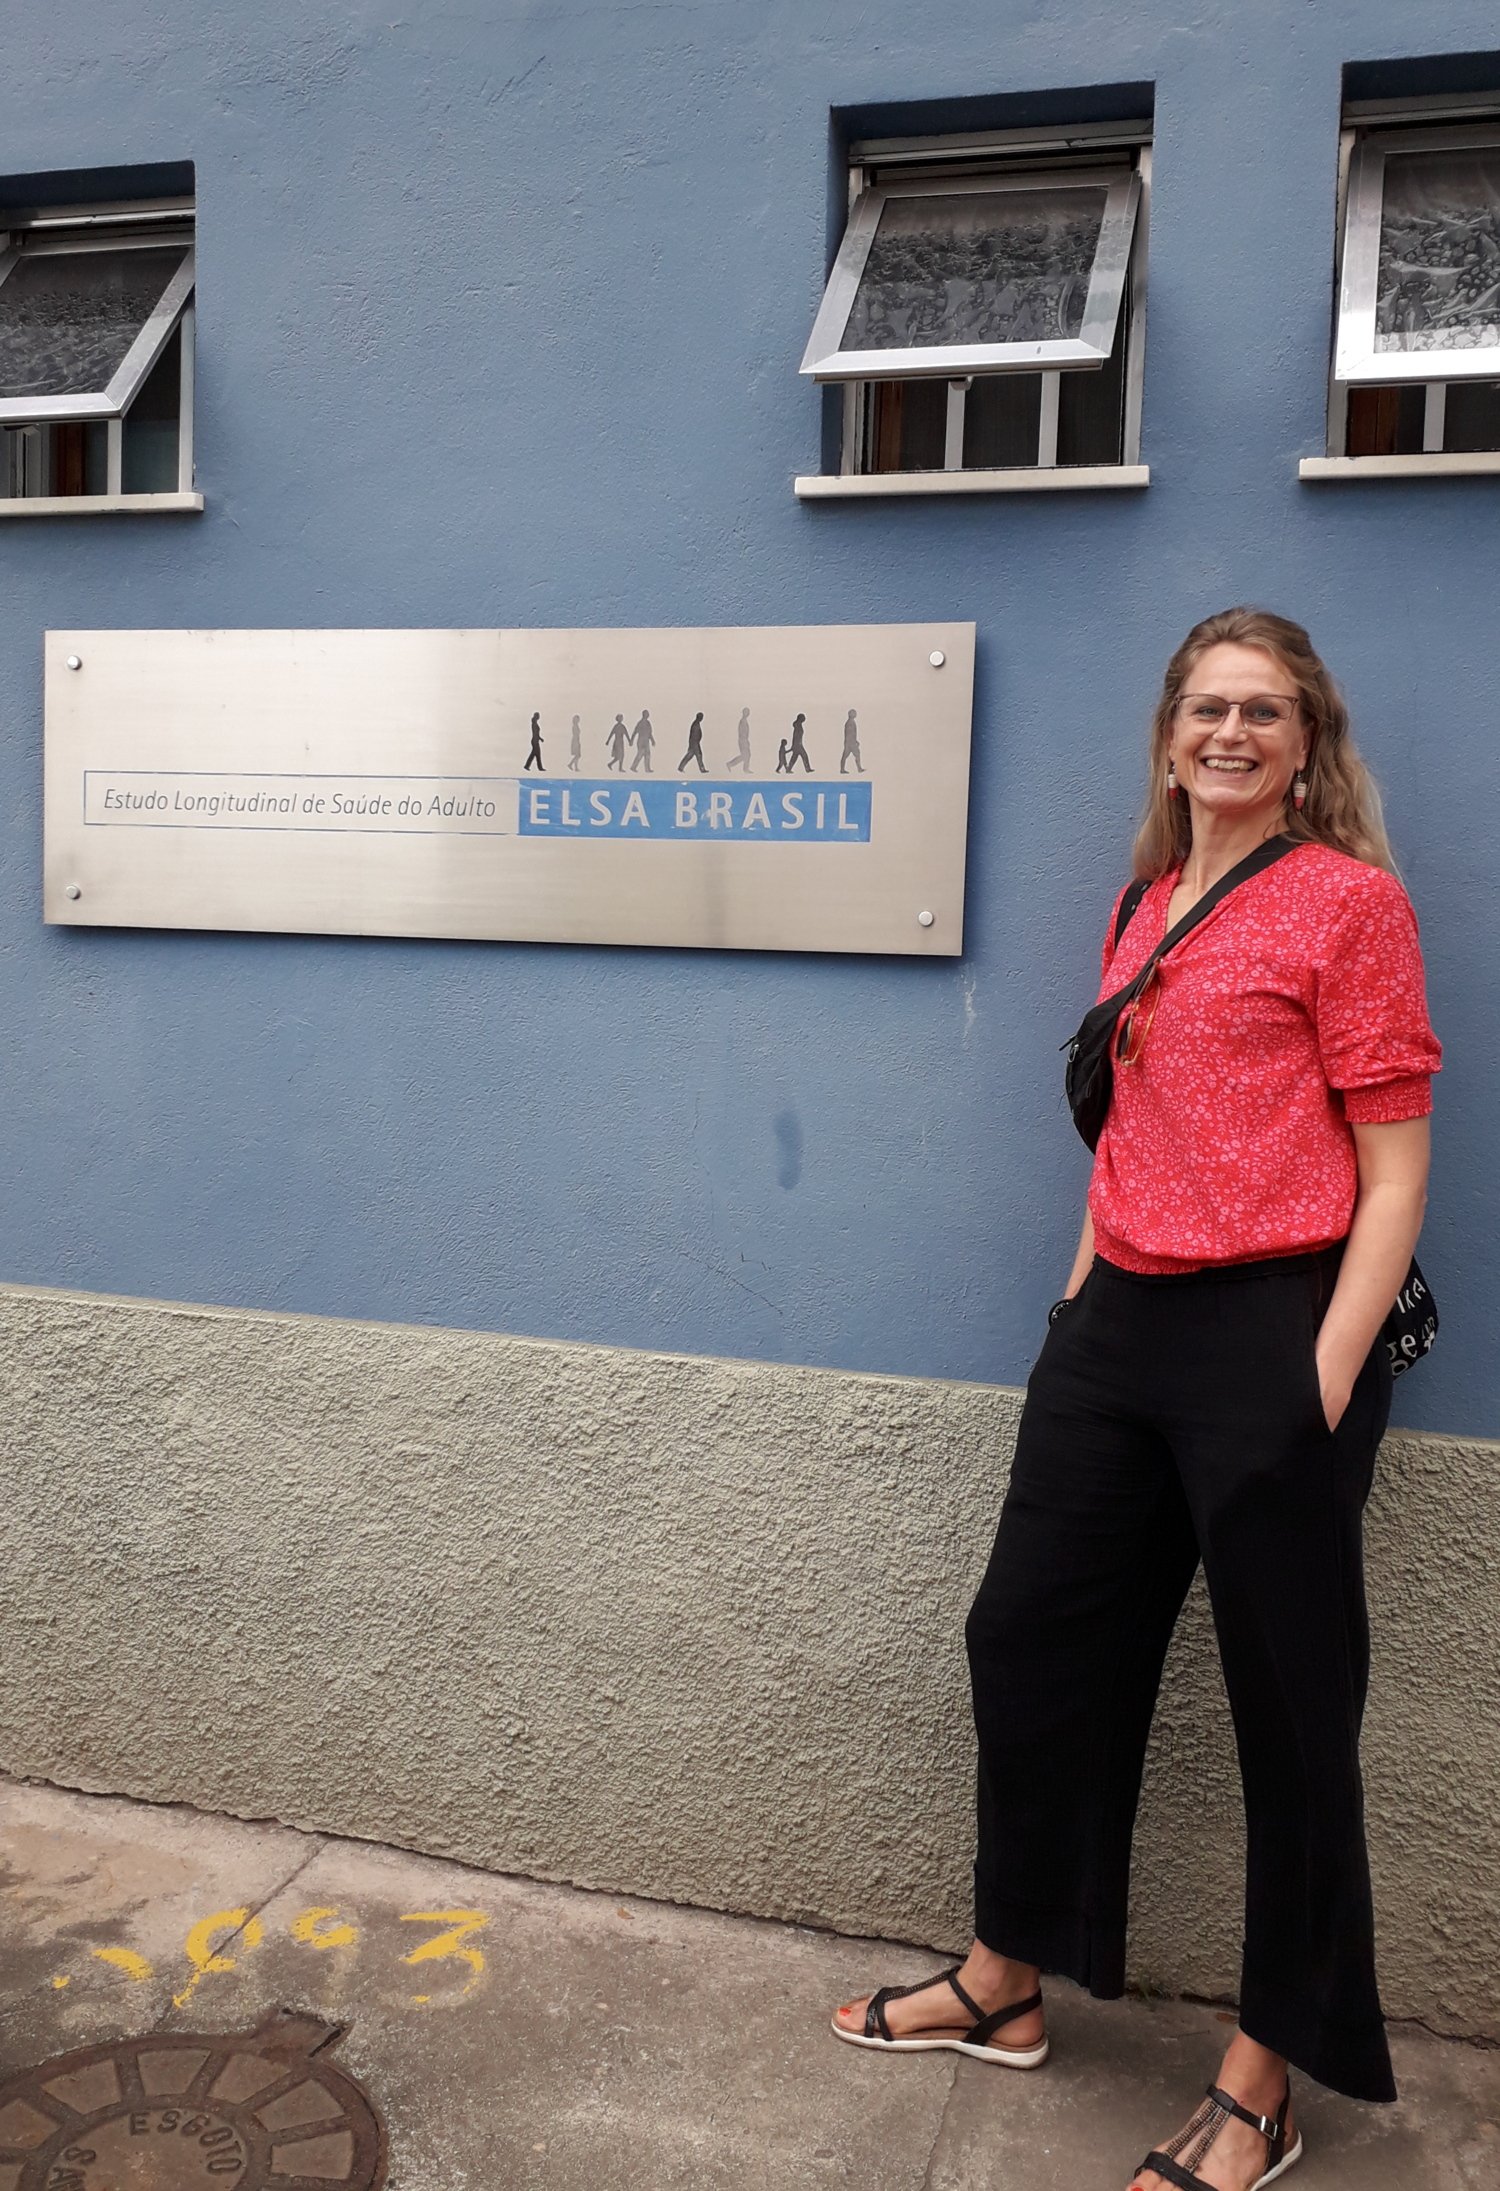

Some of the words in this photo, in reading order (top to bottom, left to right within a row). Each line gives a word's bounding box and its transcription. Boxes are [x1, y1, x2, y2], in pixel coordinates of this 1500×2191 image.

[104, 788, 168, 812] Estudo
[174, 790, 297, 816] Longitudinal
[302, 796, 325, 814] de
[330, 793, 391, 816] Saúde
[397, 797, 423, 817] do
[427, 795, 496, 818] Adulto
[529, 789, 650, 828] ELSA
[675, 792, 859, 830] BRASIL
[129, 2109, 243, 2176] ESGOTO
